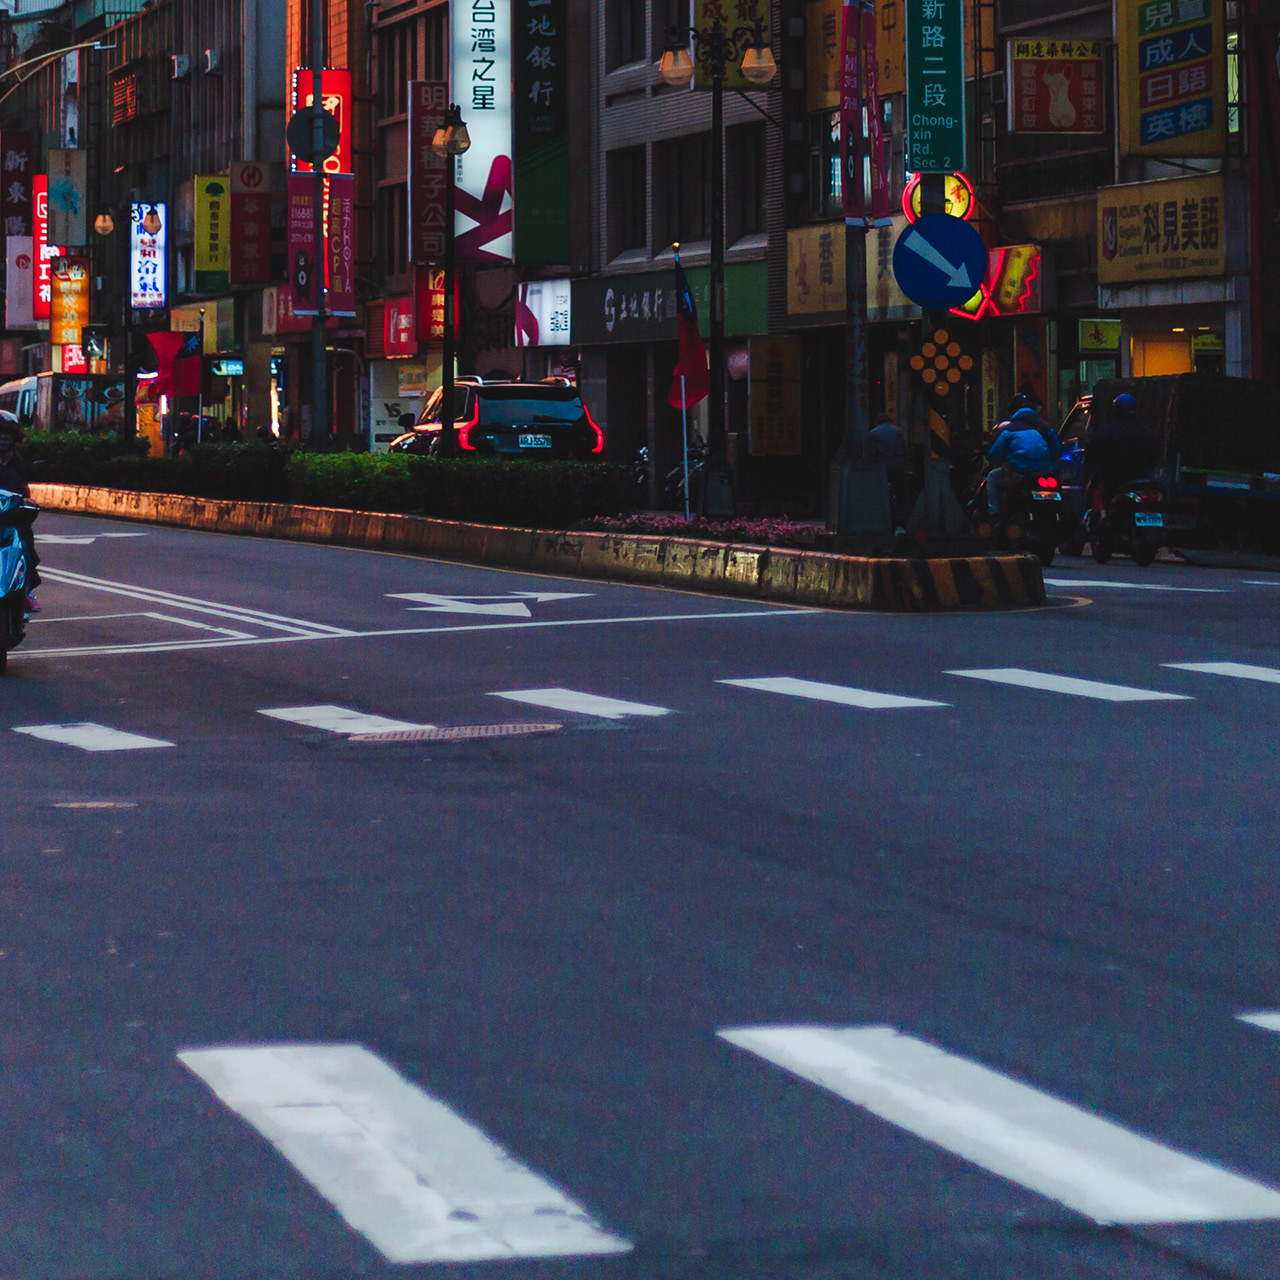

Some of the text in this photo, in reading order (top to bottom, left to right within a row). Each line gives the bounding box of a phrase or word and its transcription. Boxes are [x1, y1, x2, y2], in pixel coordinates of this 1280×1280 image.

[1145, 31, 1207, 67] 成人
[1146, 66, 1207, 104] 日語
[912, 114, 958, 128] Chong-
[913, 129, 931, 140] xin
[1147, 104, 1208, 141] 英檢
[913, 143, 932, 155] Rd.
[913, 157, 951, 168] Sec. 2
[243, 197, 260, 281] 華南銀行
[1143, 196, 1219, 254] 科見美語
[138, 260, 158, 293] 冷氣
